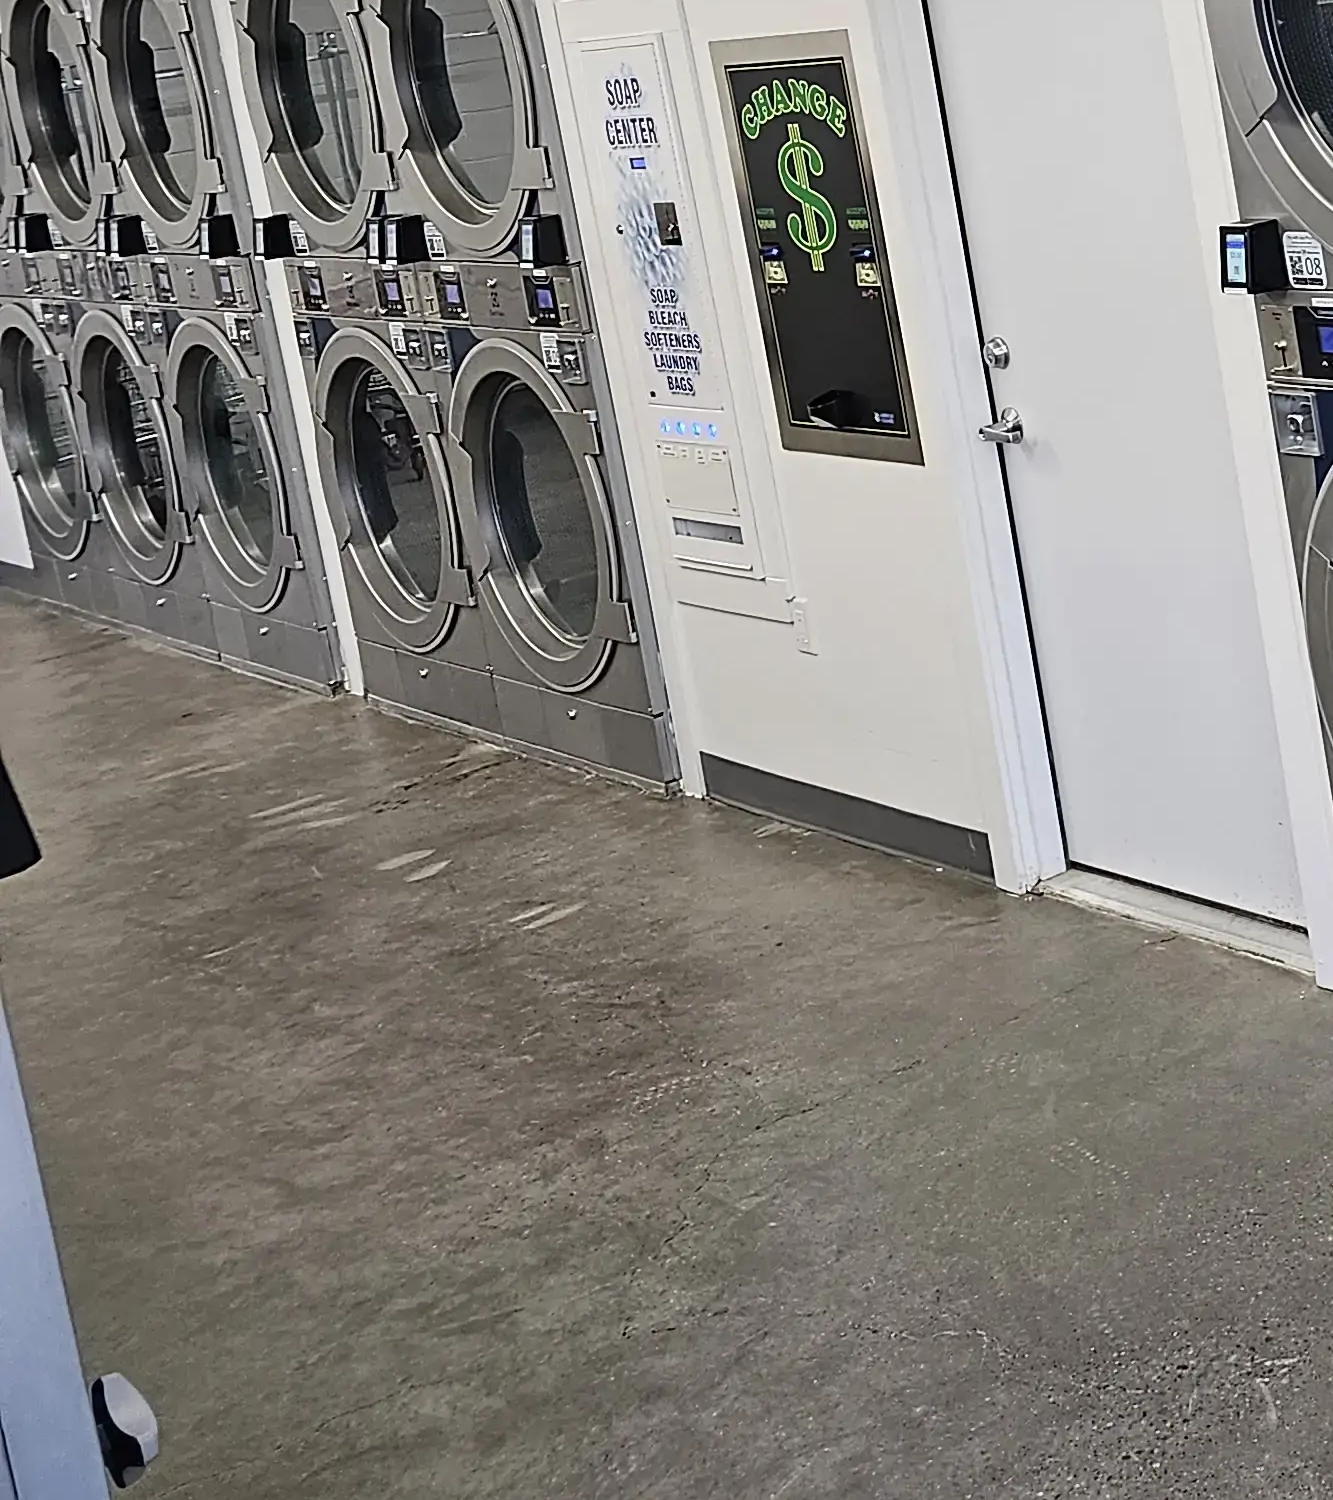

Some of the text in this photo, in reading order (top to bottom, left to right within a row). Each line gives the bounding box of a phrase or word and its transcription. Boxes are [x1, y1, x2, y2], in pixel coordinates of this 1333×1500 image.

[605, 77, 640, 107] SOAP
[741, 78, 847, 140] CHANGE
[605, 116, 659, 146] CENTER
[1304, 256, 1322, 276] 08
[650, 288, 677, 304] SOAP
[648, 310, 688, 326] BLEACH
[644, 331, 701, 350] SOFTENERS
[653, 353, 699, 371] LAUNDRY
[666, 376, 694, 392] BAGS
